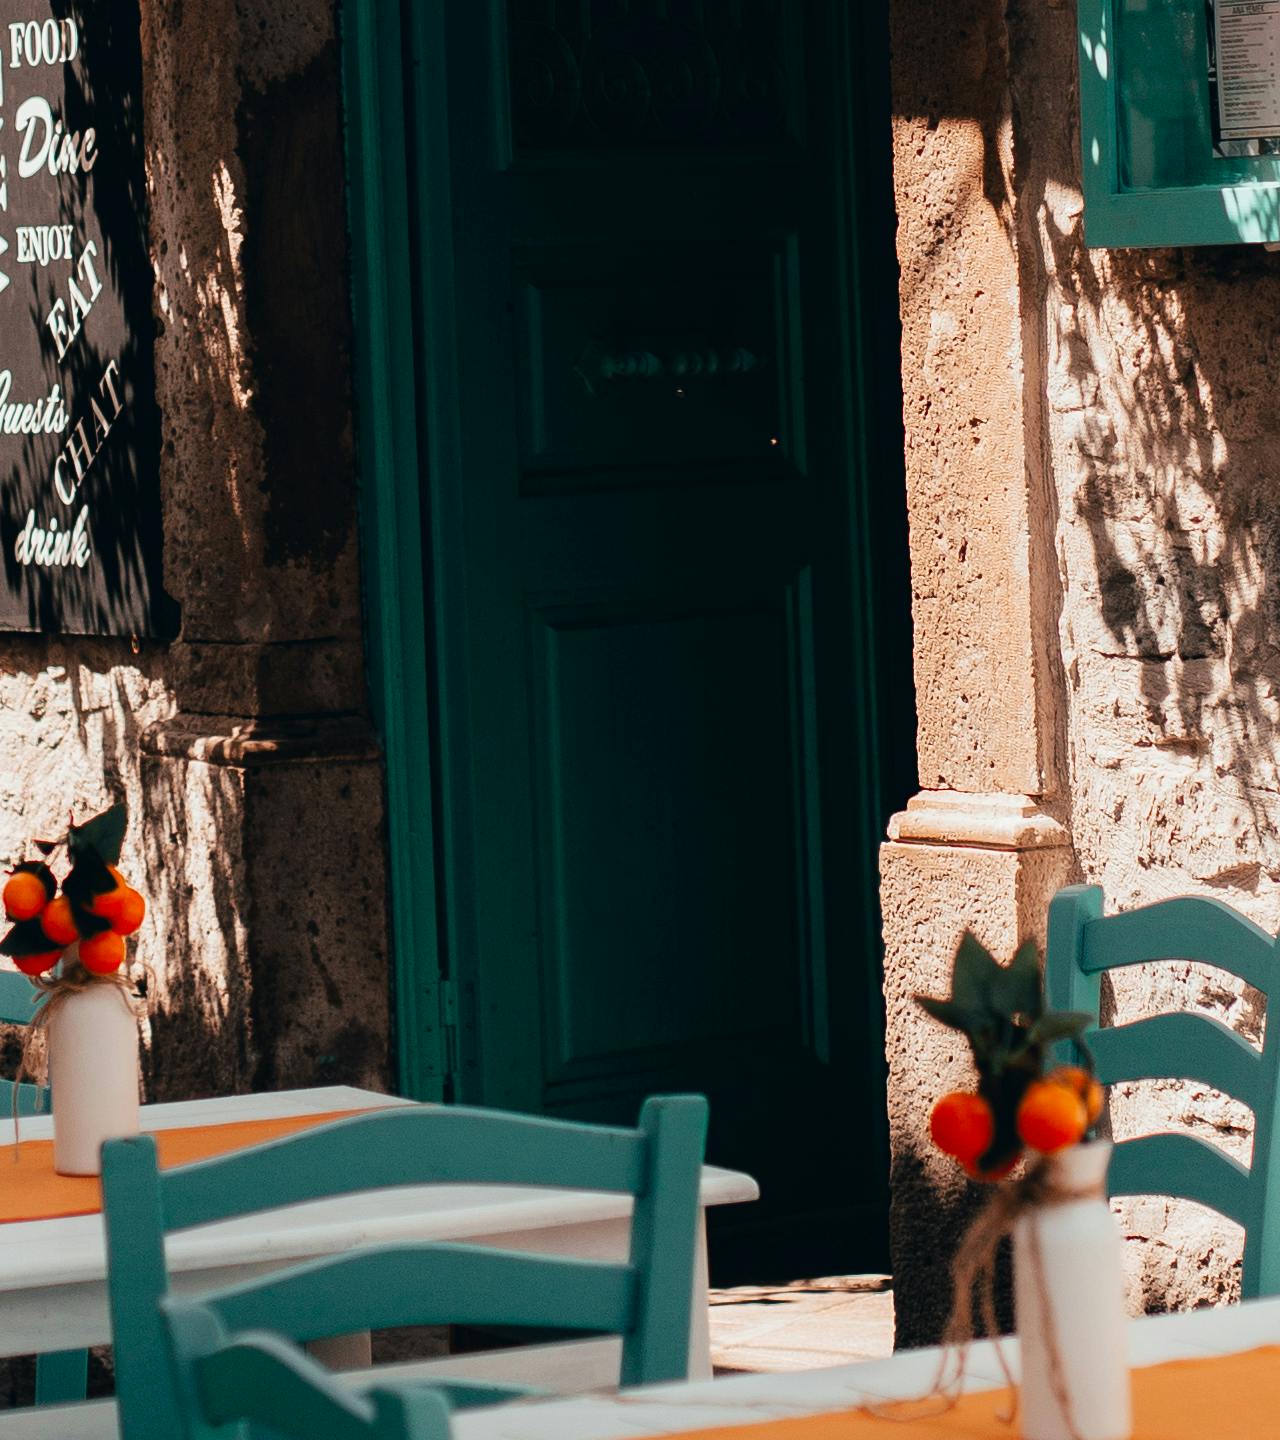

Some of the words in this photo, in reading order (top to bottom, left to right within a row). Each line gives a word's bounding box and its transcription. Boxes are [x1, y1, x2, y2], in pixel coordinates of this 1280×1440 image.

[8, 17, 79, 69] FOOD
[15, 95, 99, 179] Dine
[15, 224, 74, 267] ENJOY
[45, 239, 103, 365] EAT
[54, 359, 124, 506] CHAT
[14, 503, 91, 568] drink
